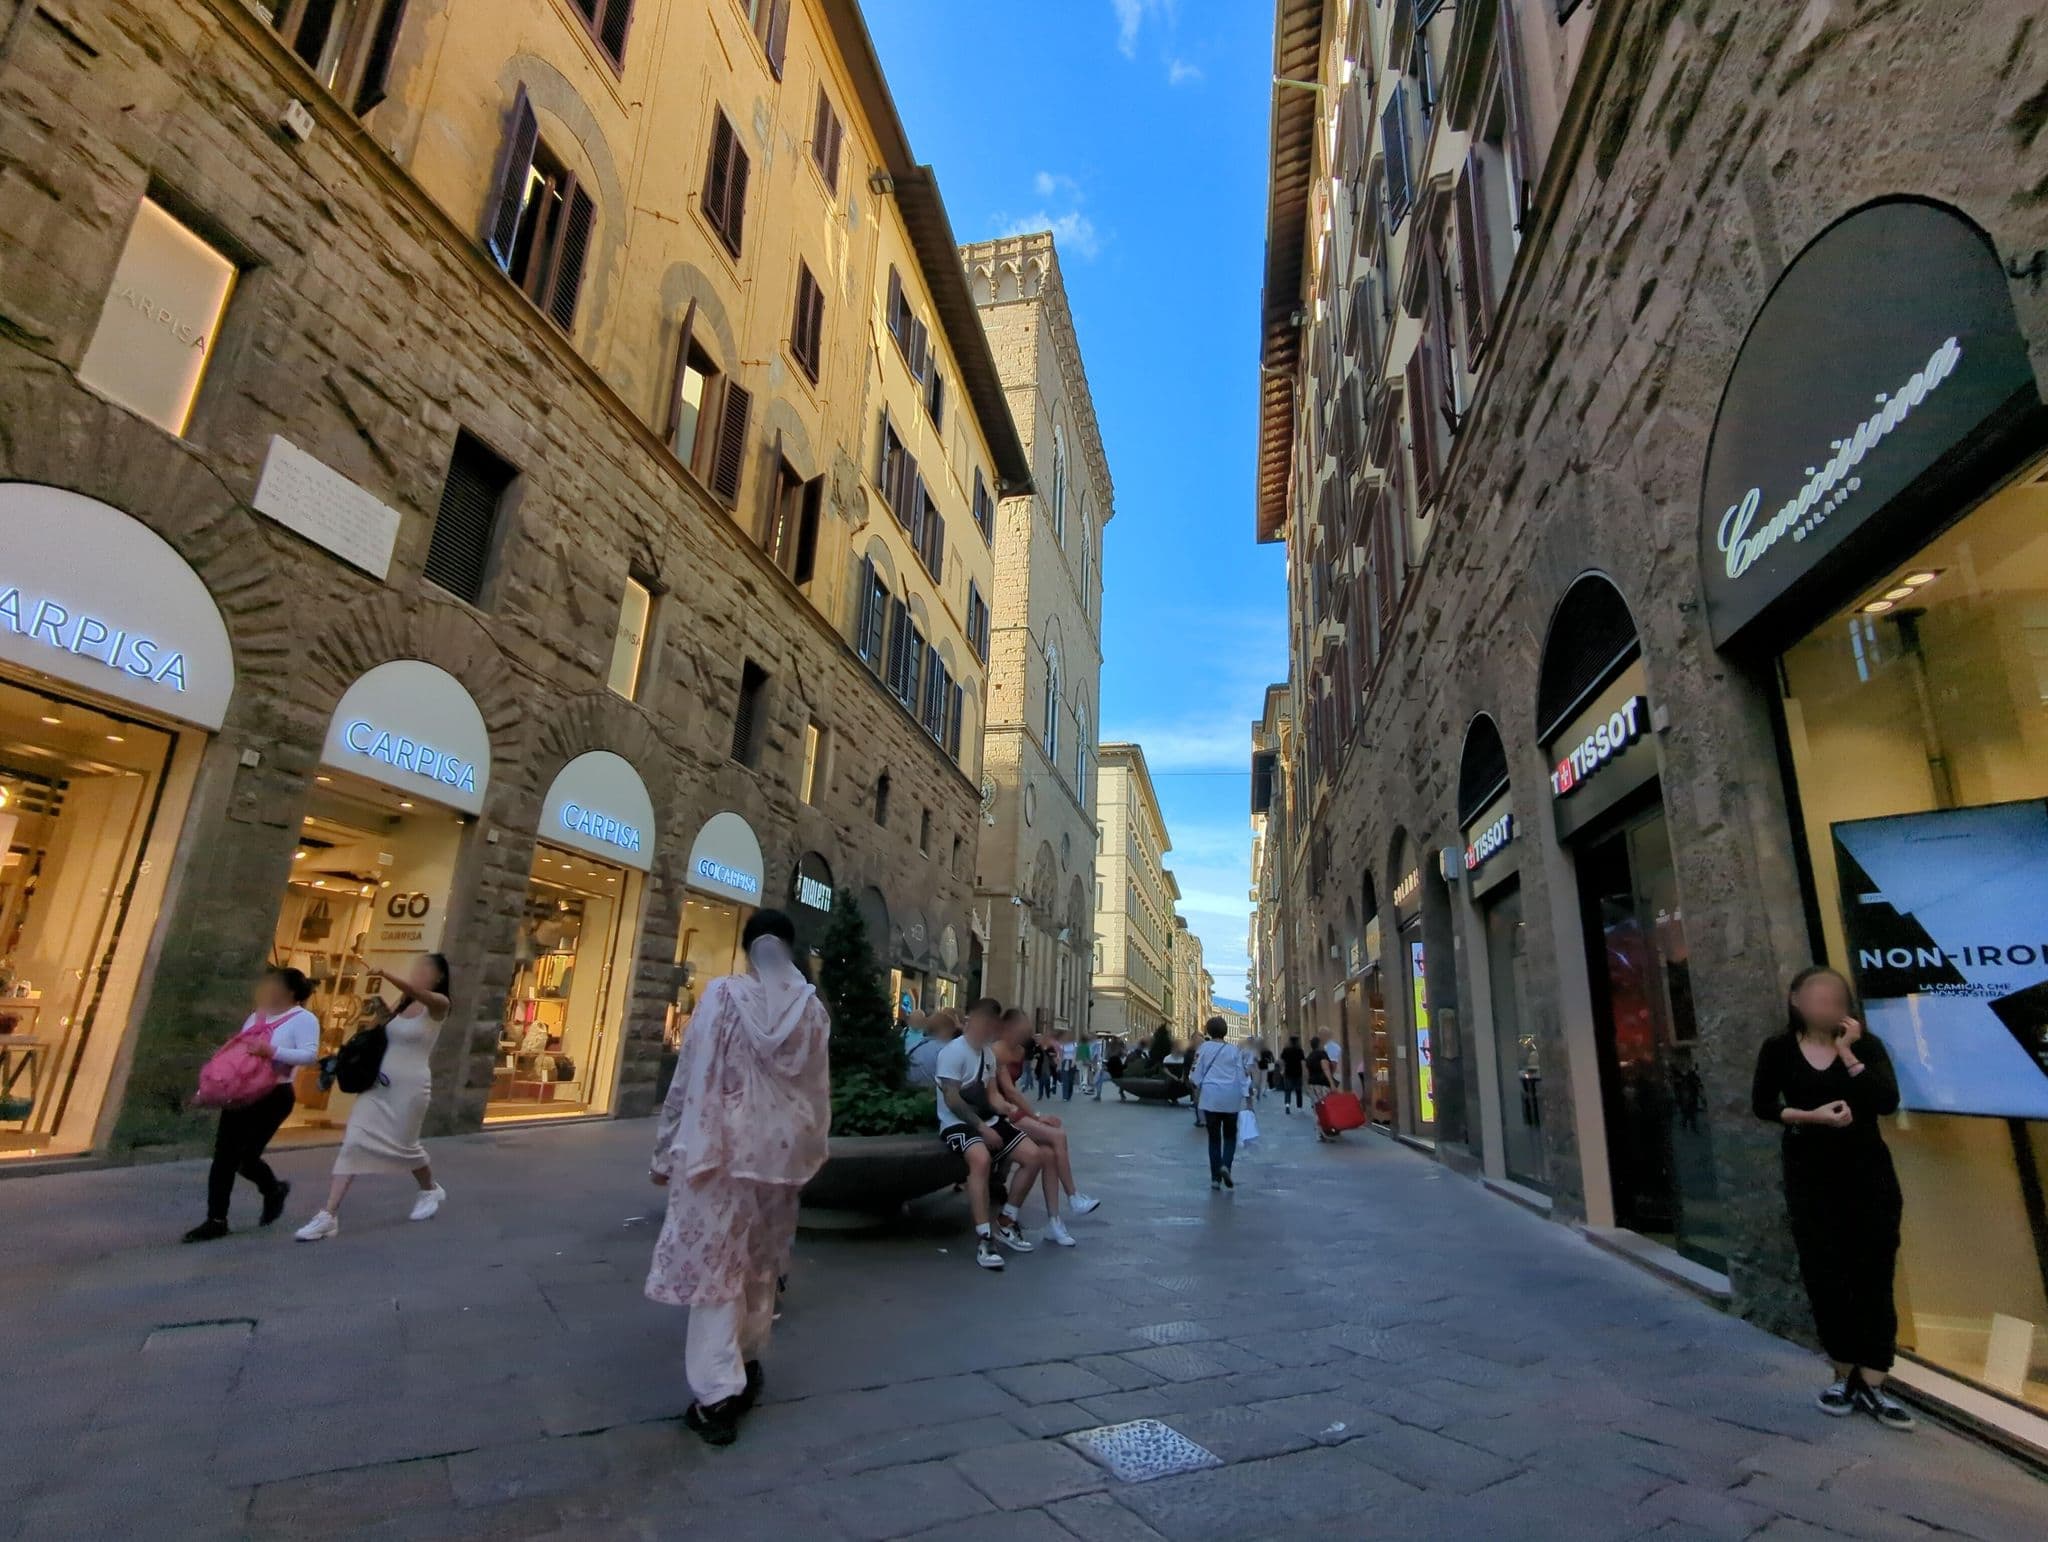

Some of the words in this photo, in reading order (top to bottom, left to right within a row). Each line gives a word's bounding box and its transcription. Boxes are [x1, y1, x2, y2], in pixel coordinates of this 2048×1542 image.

[1793, 477, 1861, 543] MILANO
[345, 720, 476, 793] CARPISA
[1569, 696, 1639, 782] TISSOT
[563, 804, 640, 852] CARPISA
[1473, 813, 1510, 863] TISSOT
[387, 893, 430, 918] GO
